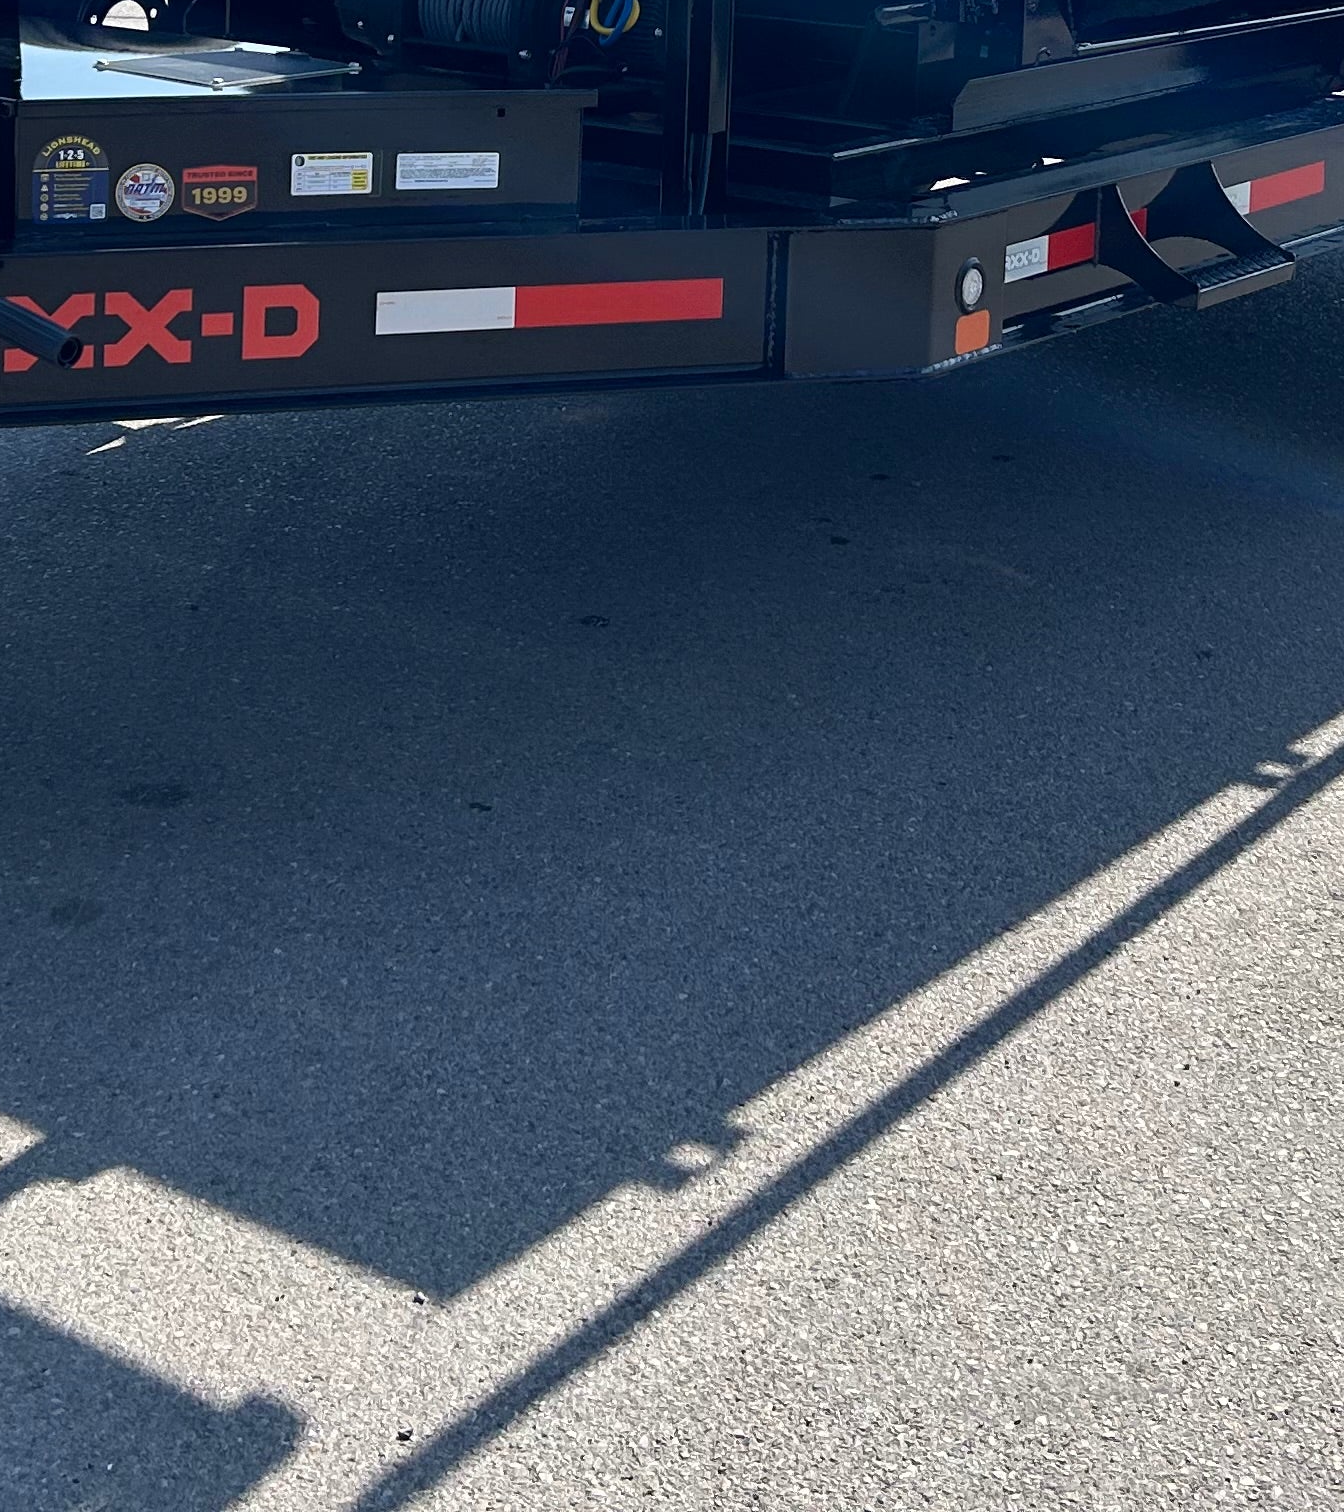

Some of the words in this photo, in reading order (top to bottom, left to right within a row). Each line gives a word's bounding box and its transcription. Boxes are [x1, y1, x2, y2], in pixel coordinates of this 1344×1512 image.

[42, 135, 102, 158] LIONSHEAD
[186, 170, 226, 180] TRUSTED
[191, 186, 248, 205] 1999
